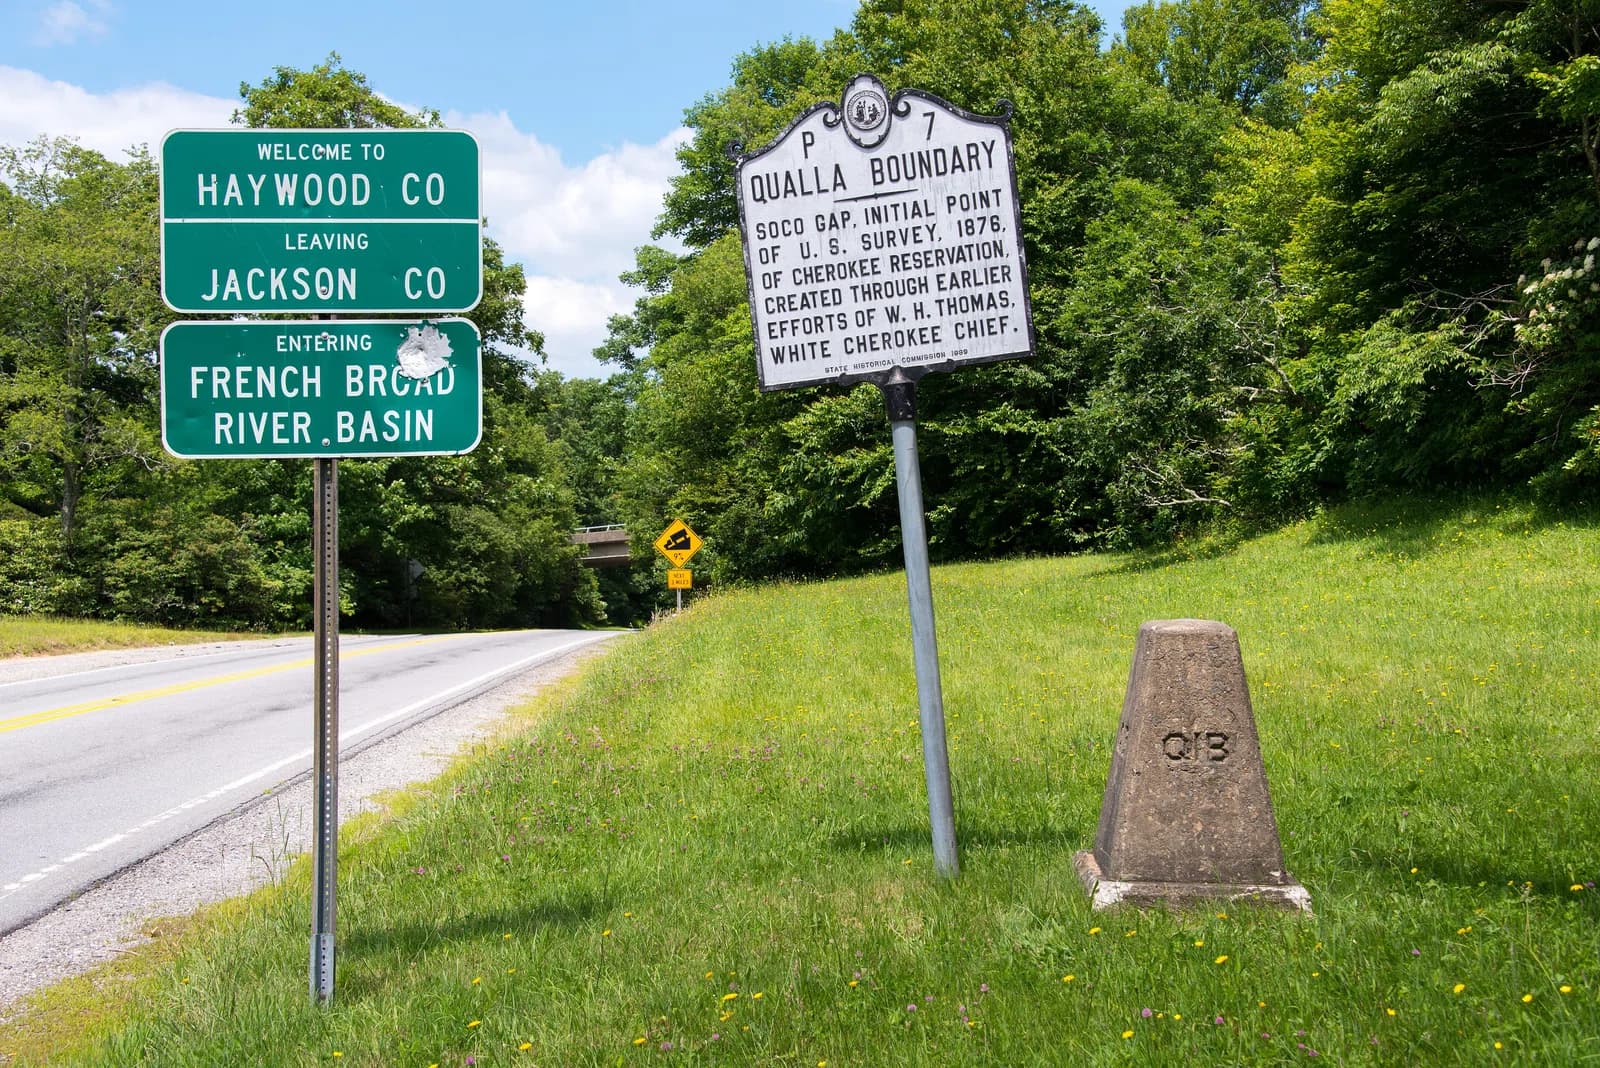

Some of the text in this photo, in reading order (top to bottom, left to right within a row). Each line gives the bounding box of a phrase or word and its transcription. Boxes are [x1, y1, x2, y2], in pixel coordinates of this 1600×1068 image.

[257, 143, 385, 161] WELCOME TO
[802, 111, 935, 159] P 7
[198, 172, 445, 206] HAYWOOD CO
[750, 139, 996, 204] QUALLA BOUNDARY
[756, 188, 1002, 241] SOCO GAP, INITIAL POINT
[285, 233, 369, 251] LEAVING
[759, 214, 1006, 265] OF U. S. SURVEY, 1876,
[201, 267, 446, 301] JACKSON CO
[762, 239, 1009, 290] OF CHEROKEE RESERVATION,
[764, 264, 1012, 315] CREATED THROUGH EARLIER
[767, 290, 1016, 340] EFFORTS OF W. H. THOMAS,
[276, 335, 372, 352] ENTERING
[770, 315, 1018, 365] WHITE CHEROKEE CHIEF.
[191, 365, 321, 399] FRENCH
[824, 365, 849, 374] STATE
[853, 359, 896, 370] HISTORICAL
[901, 351, 946, 364] COMMISSION
[214, 409, 434, 445] RIVER BASIN
